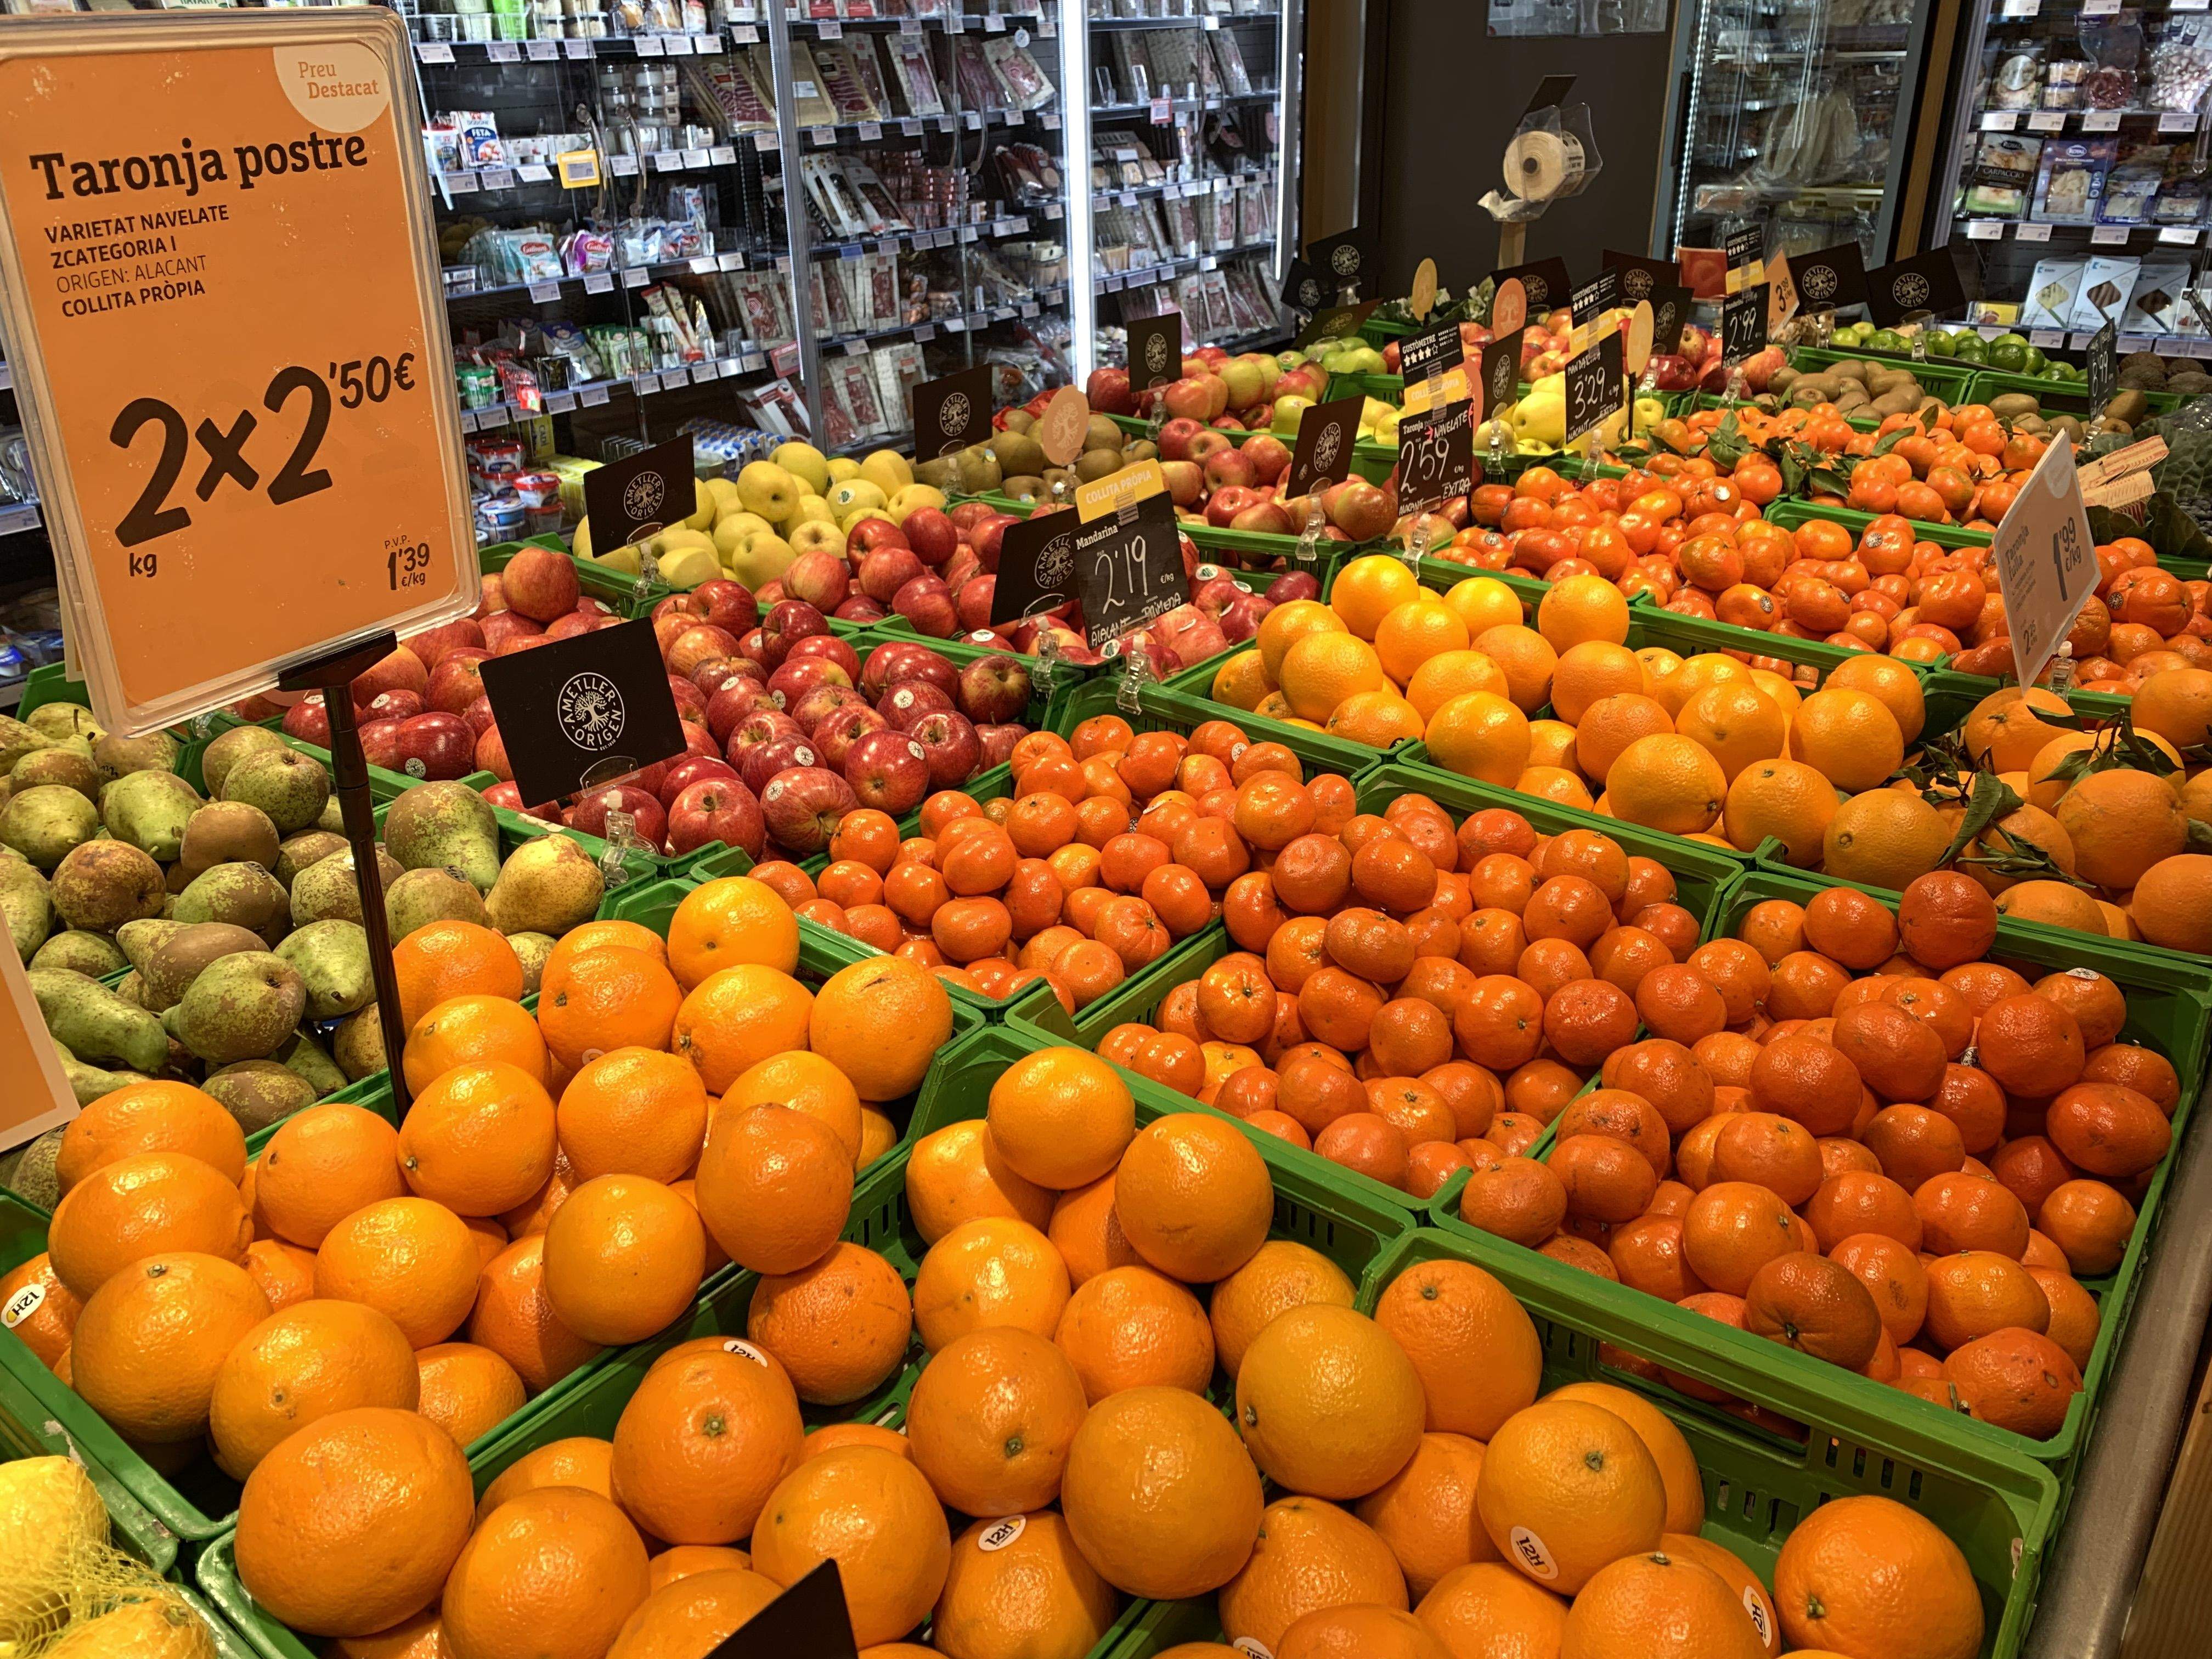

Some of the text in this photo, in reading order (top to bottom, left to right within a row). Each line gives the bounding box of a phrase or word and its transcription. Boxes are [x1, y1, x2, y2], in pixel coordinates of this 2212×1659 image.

[299, 61, 336, 79] Preu
[307, 79, 380, 99] Destacat
[471, 128, 492, 137] FETA
[30, 131, 368, 200] Taronja postre
[1983, 168, 2025, 179] CARPACCIO
[45, 205, 229, 244] VARIETAT NAVELATE
[51, 236, 177, 269] ZCATEGORIA I
[57, 255, 207, 294] ORIGEN: ALACANT
[61, 279, 206, 318] COLLITA PRÒPIA
[1575, 366, 1606, 420] 3'29
[1403, 420, 1424, 435] Taronja
[1434, 410, 1468, 438] NAVELATE
[1401, 438, 1450, 494] 2'59
[627, 474, 662, 505] AMETLLER
[1086, 470, 1153, 504] COLLITA PRÒPIA
[1442, 477, 1472, 499] EXTRA
[631, 492, 662, 517] ORIGEN
[1076, 524, 1119, 550] Mandarina
[2005, 524, 2029, 565] Taronja
[129, 552, 157, 577] kg
[387, 543, 431, 591] 1'39
[1039, 538, 1071, 569] AMETLL
[2009, 554, 2023, 582] fulla
[2053, 516, 2076, 602] 1'99
[2066, 545, 2083, 573] €/kg
[401, 571, 426, 587] €/kg
[1095, 535, 1149, 614] 2'19
[1160, 572, 1175, 584] €/kg
[562, 678, 616, 724] AMETLLER
[574, 710, 623, 747] ORIGEN
[12, 1291, 40, 1317] 12H
[985, 1523, 1014, 1545] 12H
[1519, 1536, 1545, 1567] 12H
